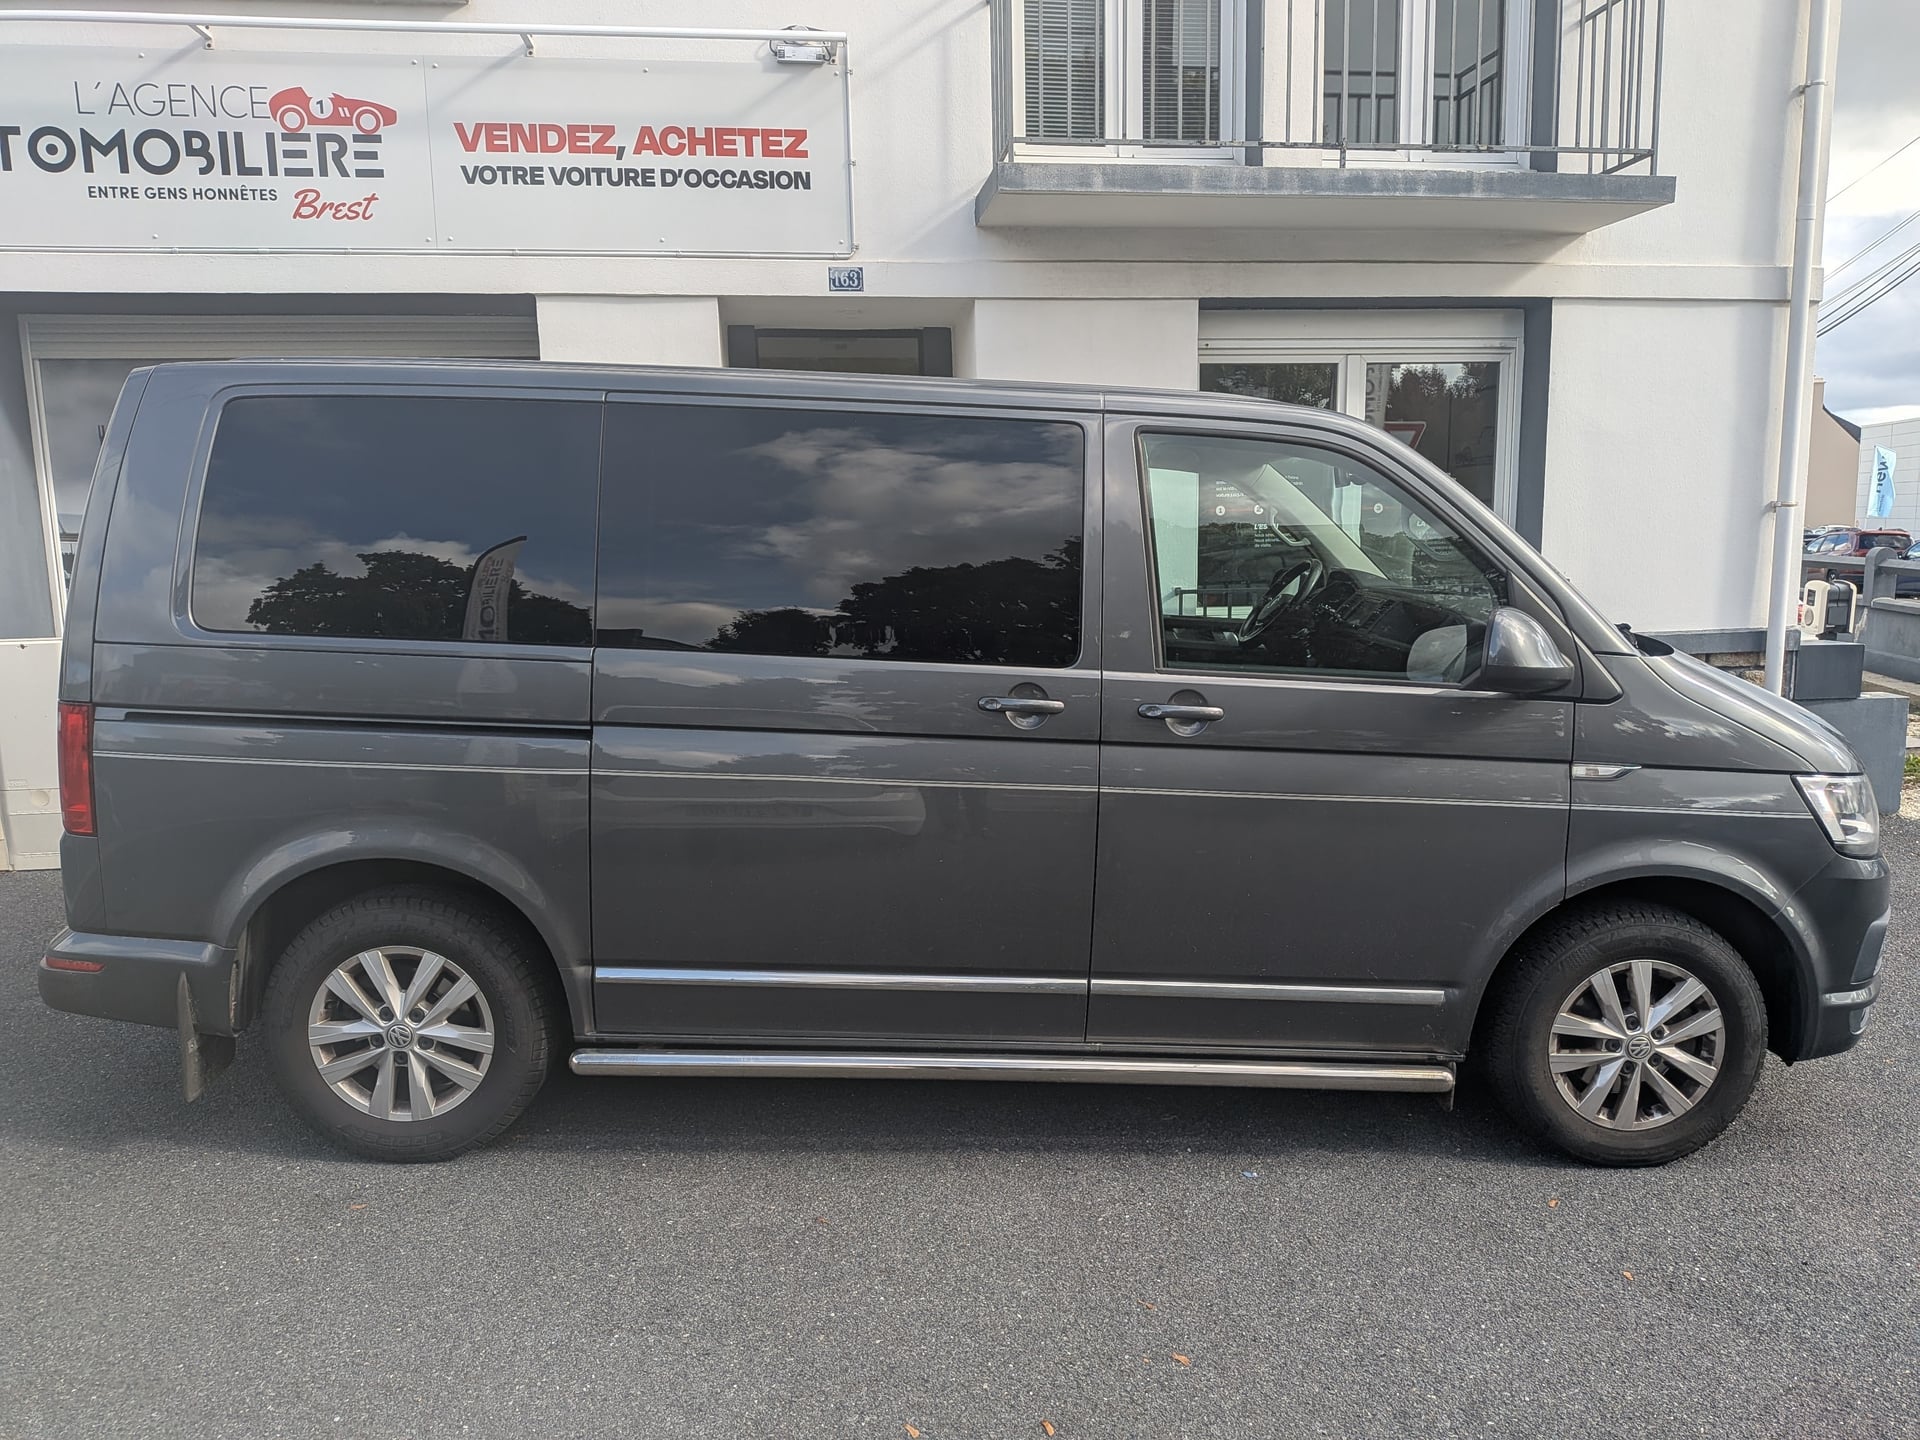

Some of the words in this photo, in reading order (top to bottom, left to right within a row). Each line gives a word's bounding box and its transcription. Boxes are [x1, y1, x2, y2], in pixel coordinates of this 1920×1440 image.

[74, 80, 271, 119] L'AGENCE
[315, 98, 325, 115] 1
[453, 122, 627, 161] VENDEZ,
[632, 125, 809, 159] ACHETEZ
[460, 165, 545, 186] VOTRE
[548, 166, 656, 187] VOITURE
[660, 168, 811, 190] D'OCCASION
[88, 185, 140, 199] ENTRE
[144, 186, 188, 200] GENS
[193, 184, 278, 201] HONNÊTES
[292, 188, 380, 221] Brest
[833, 270, 860, 288] 163
